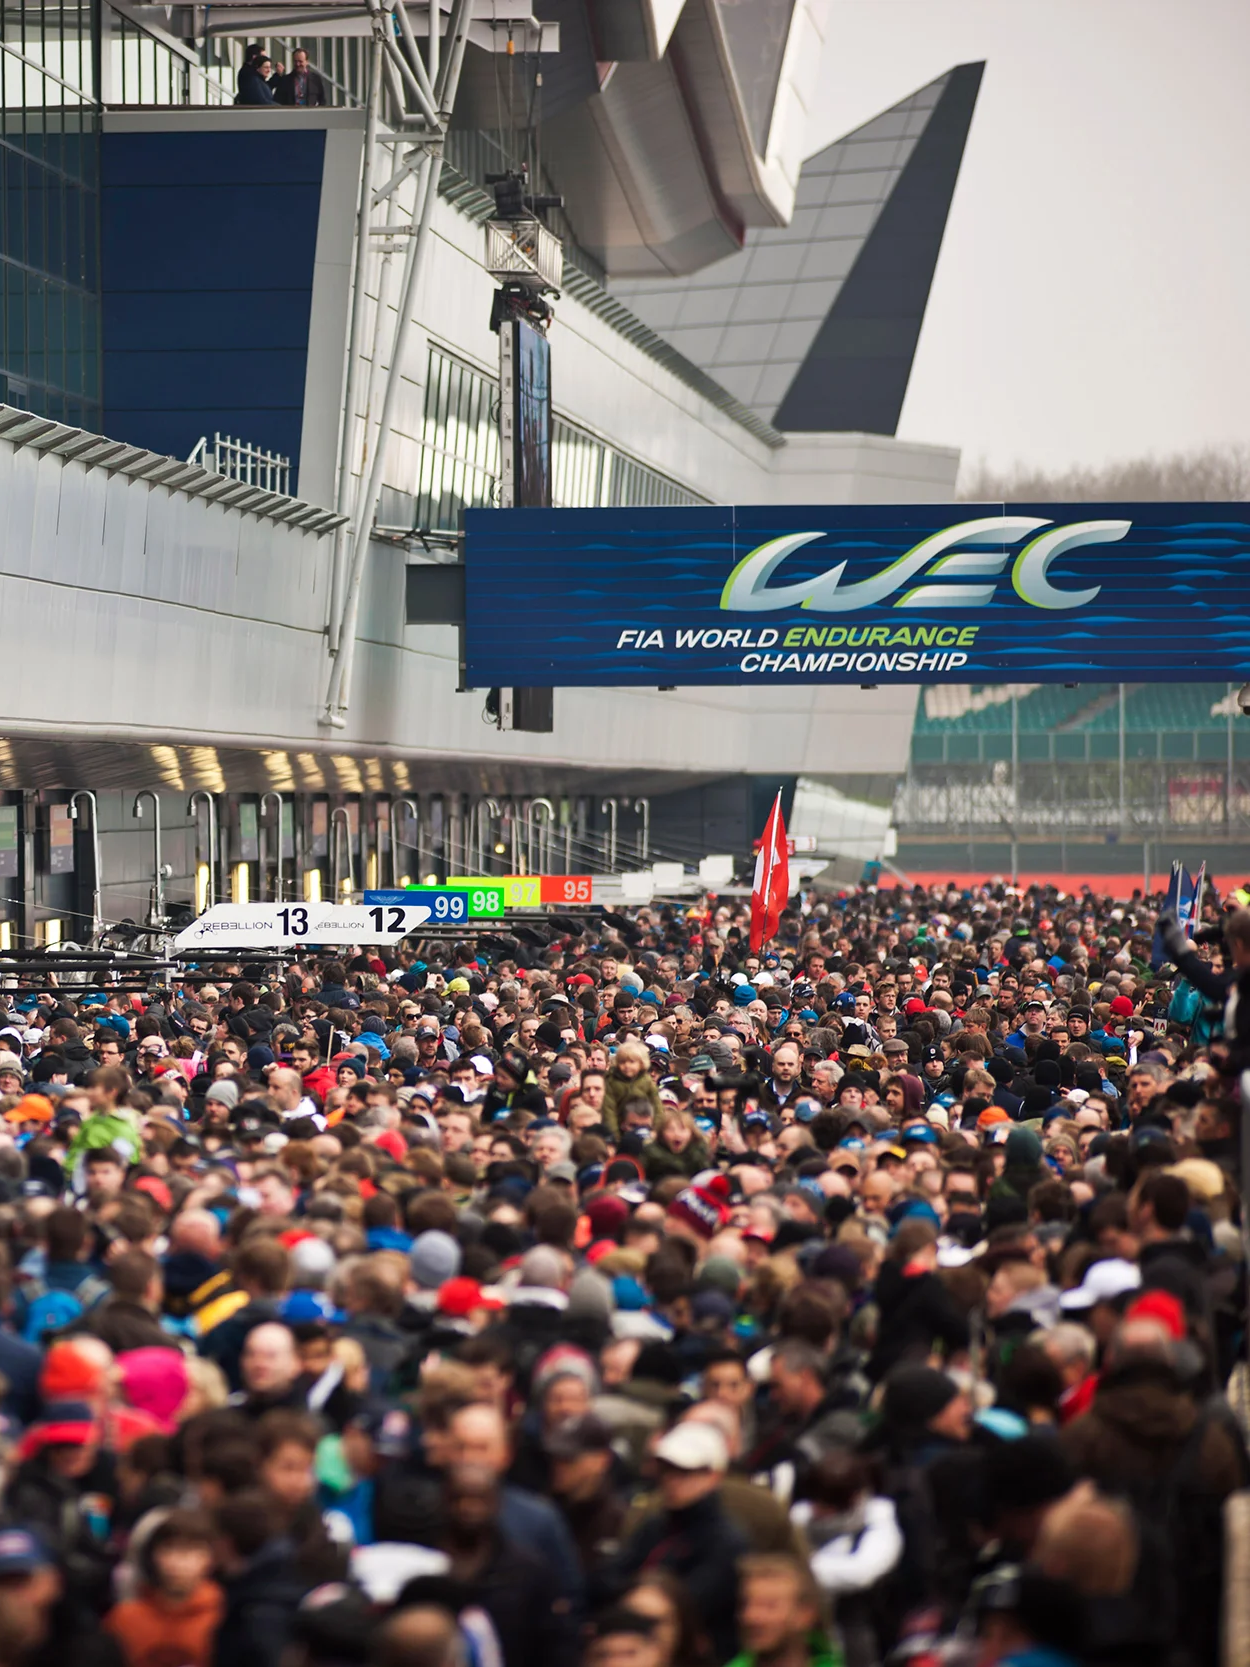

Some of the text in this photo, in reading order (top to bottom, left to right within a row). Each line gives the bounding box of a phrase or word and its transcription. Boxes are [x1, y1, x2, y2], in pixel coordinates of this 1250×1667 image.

[720, 516, 1132, 612] WEC
[616, 626, 979, 650] FIA WORLD ENDURANCE
[739, 652, 967, 673] CHAMPIONSHIP
[472, 891, 500, 913] 98
[510, 883, 536, 903] 97
[563, 881, 589, 900] 95
[368, 907, 406, 933] 12
[434, 896, 464, 920] 99
[203, 907, 309, 936] REBELLION 13
